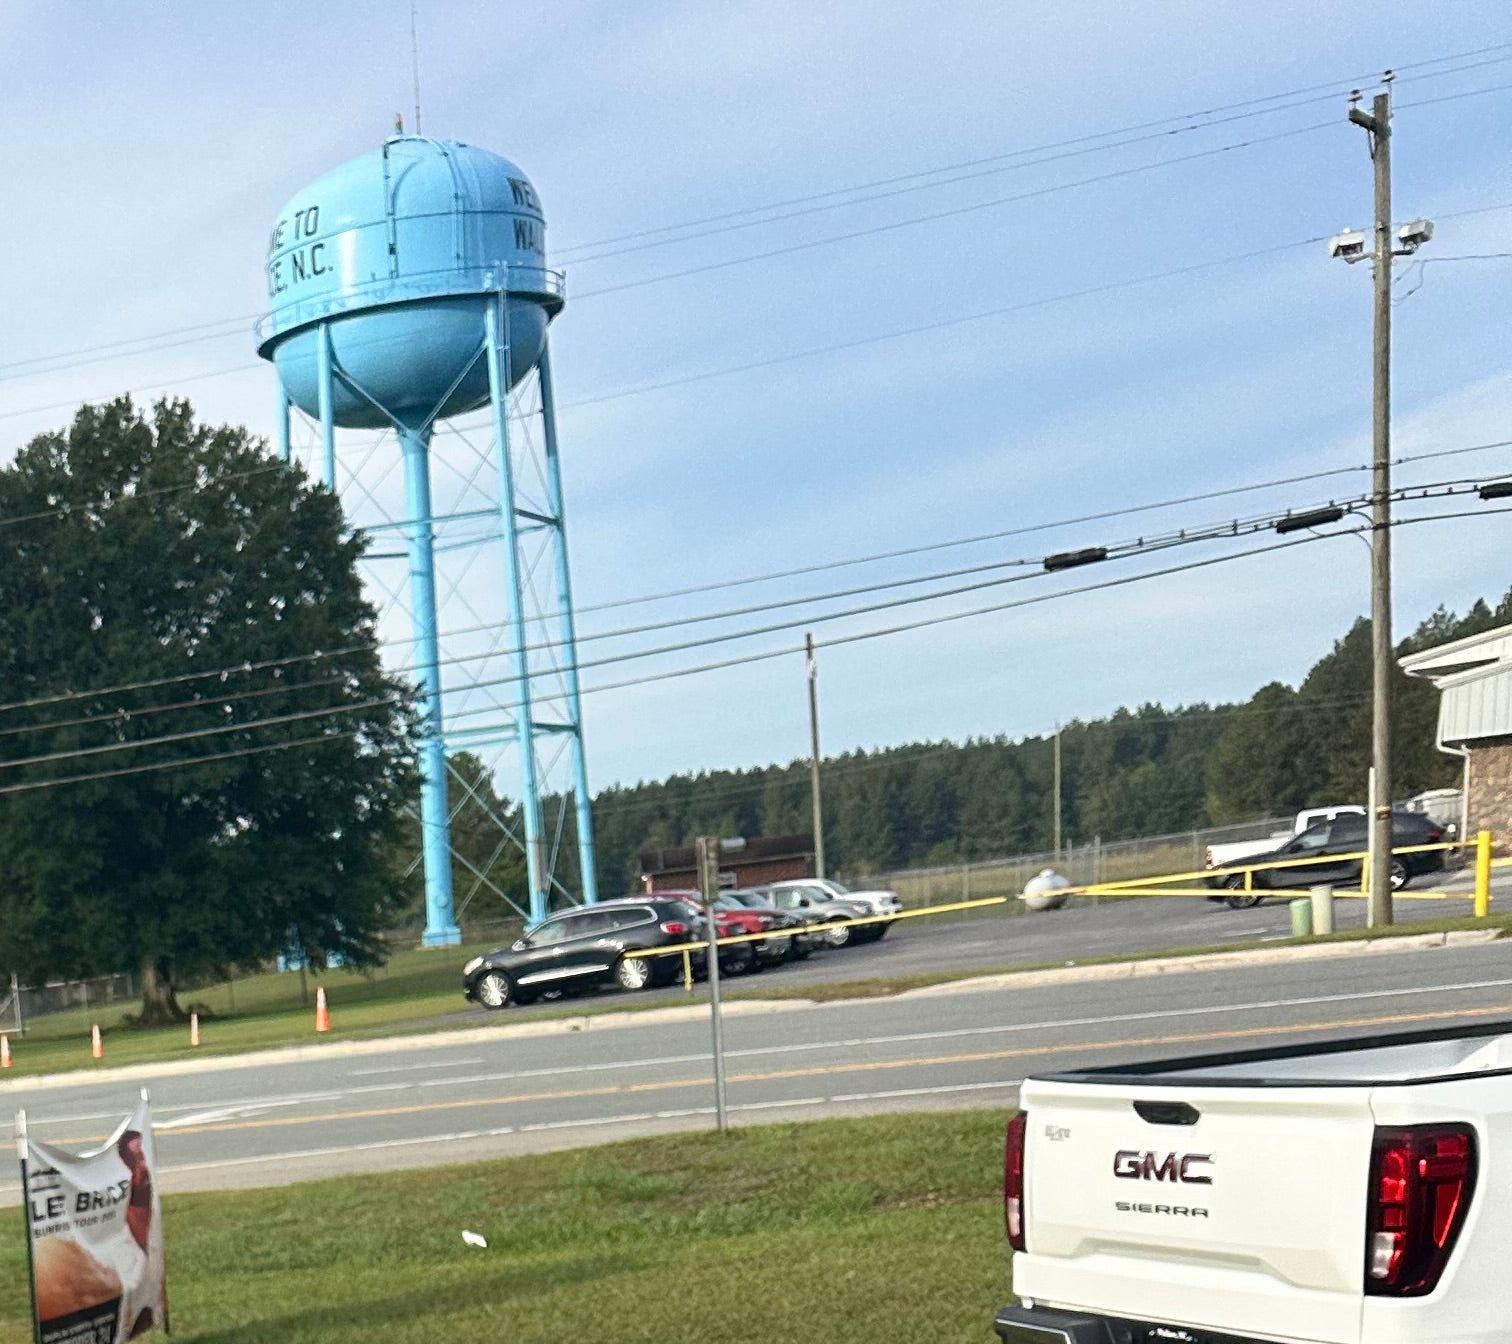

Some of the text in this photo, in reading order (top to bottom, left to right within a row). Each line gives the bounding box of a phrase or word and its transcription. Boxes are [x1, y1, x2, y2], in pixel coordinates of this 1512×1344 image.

[294, 205, 320, 241] TO
[292, 243, 335, 284] N.C.
[1113, 1149, 1216, 1185] GMC
[1115, 1201, 1209, 1218] SIERRA
